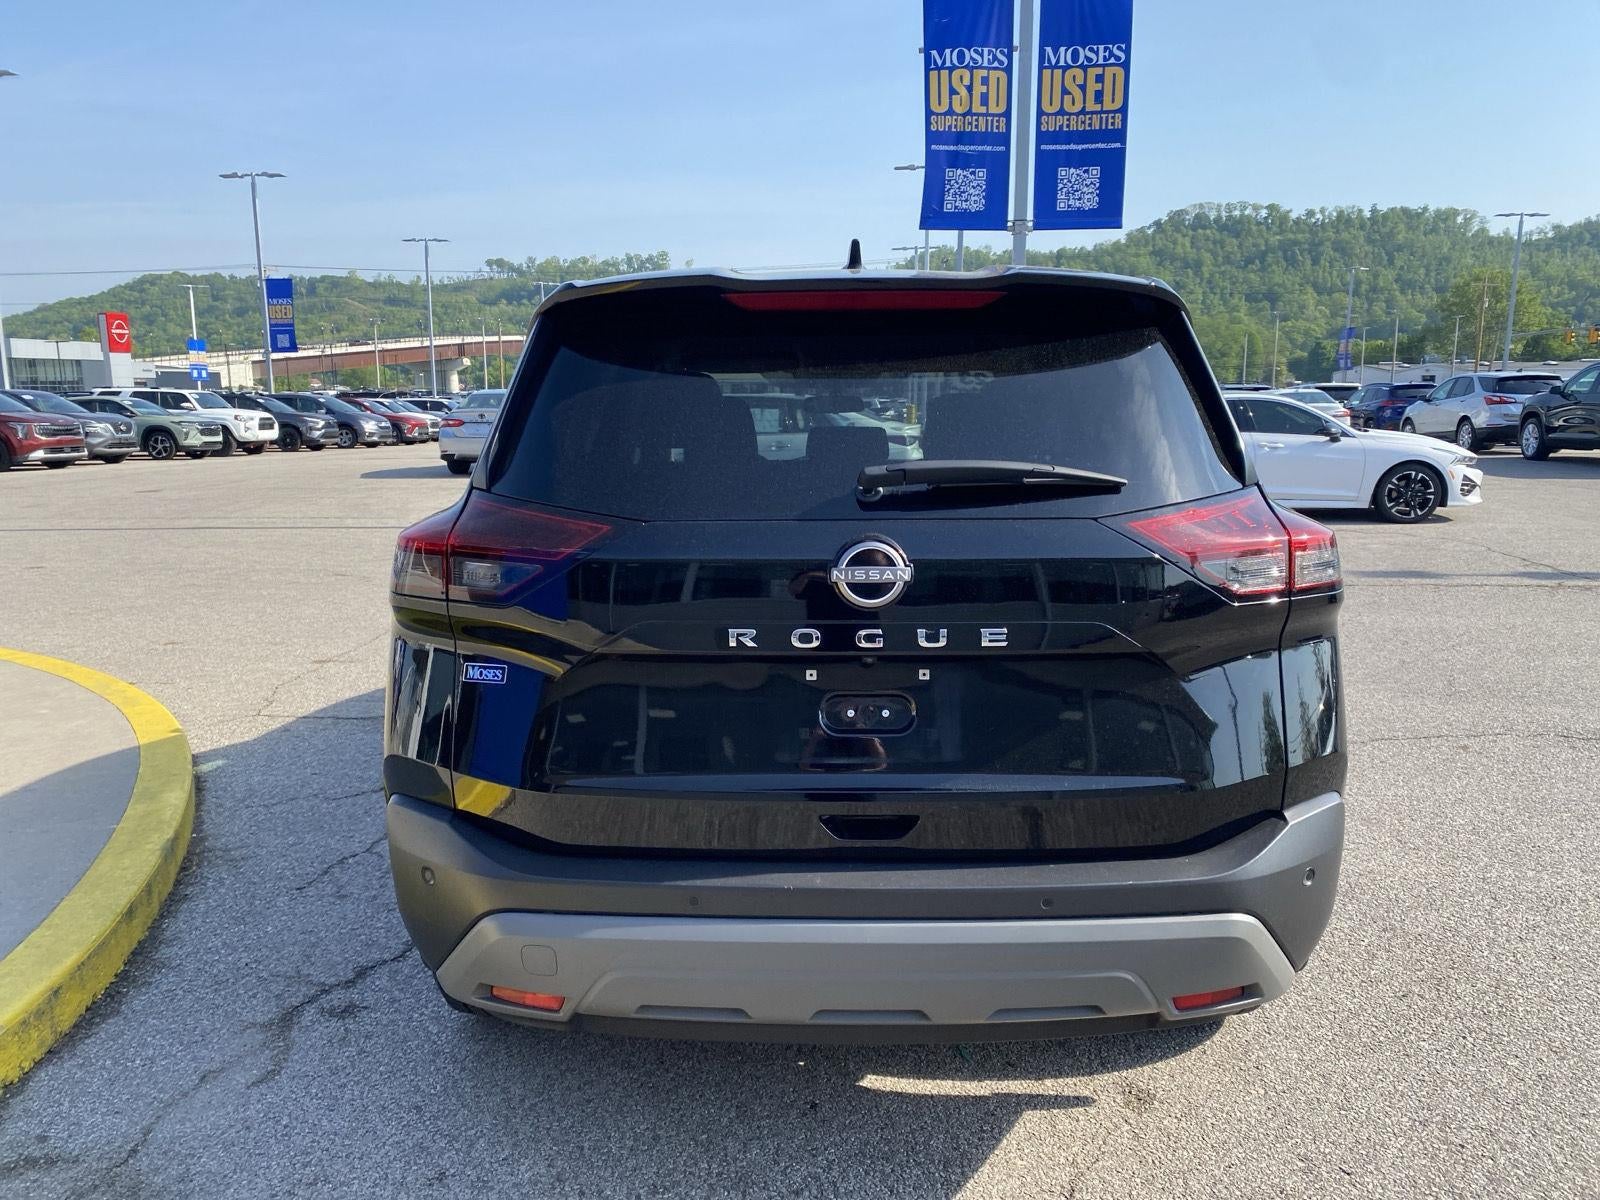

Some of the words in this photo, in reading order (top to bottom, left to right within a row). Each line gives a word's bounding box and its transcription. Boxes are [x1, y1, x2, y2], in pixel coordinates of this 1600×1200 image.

[929, 47, 1009, 68] MOSES
[1043, 43, 1126, 67] MOSES
[929, 69, 1008, 114] USED
[1041, 67, 1124, 114] USED
[930, 115, 1006, 133] SUPERCENTER
[1040, 114, 1122, 132] SUPERCENTER
[931, 144, 1006, 152] mosesusedsupercenter.com
[269, 305, 293, 319] USED
[832, 569, 910, 581] NISSAN
[727, 628, 1009, 648] ROGUE
